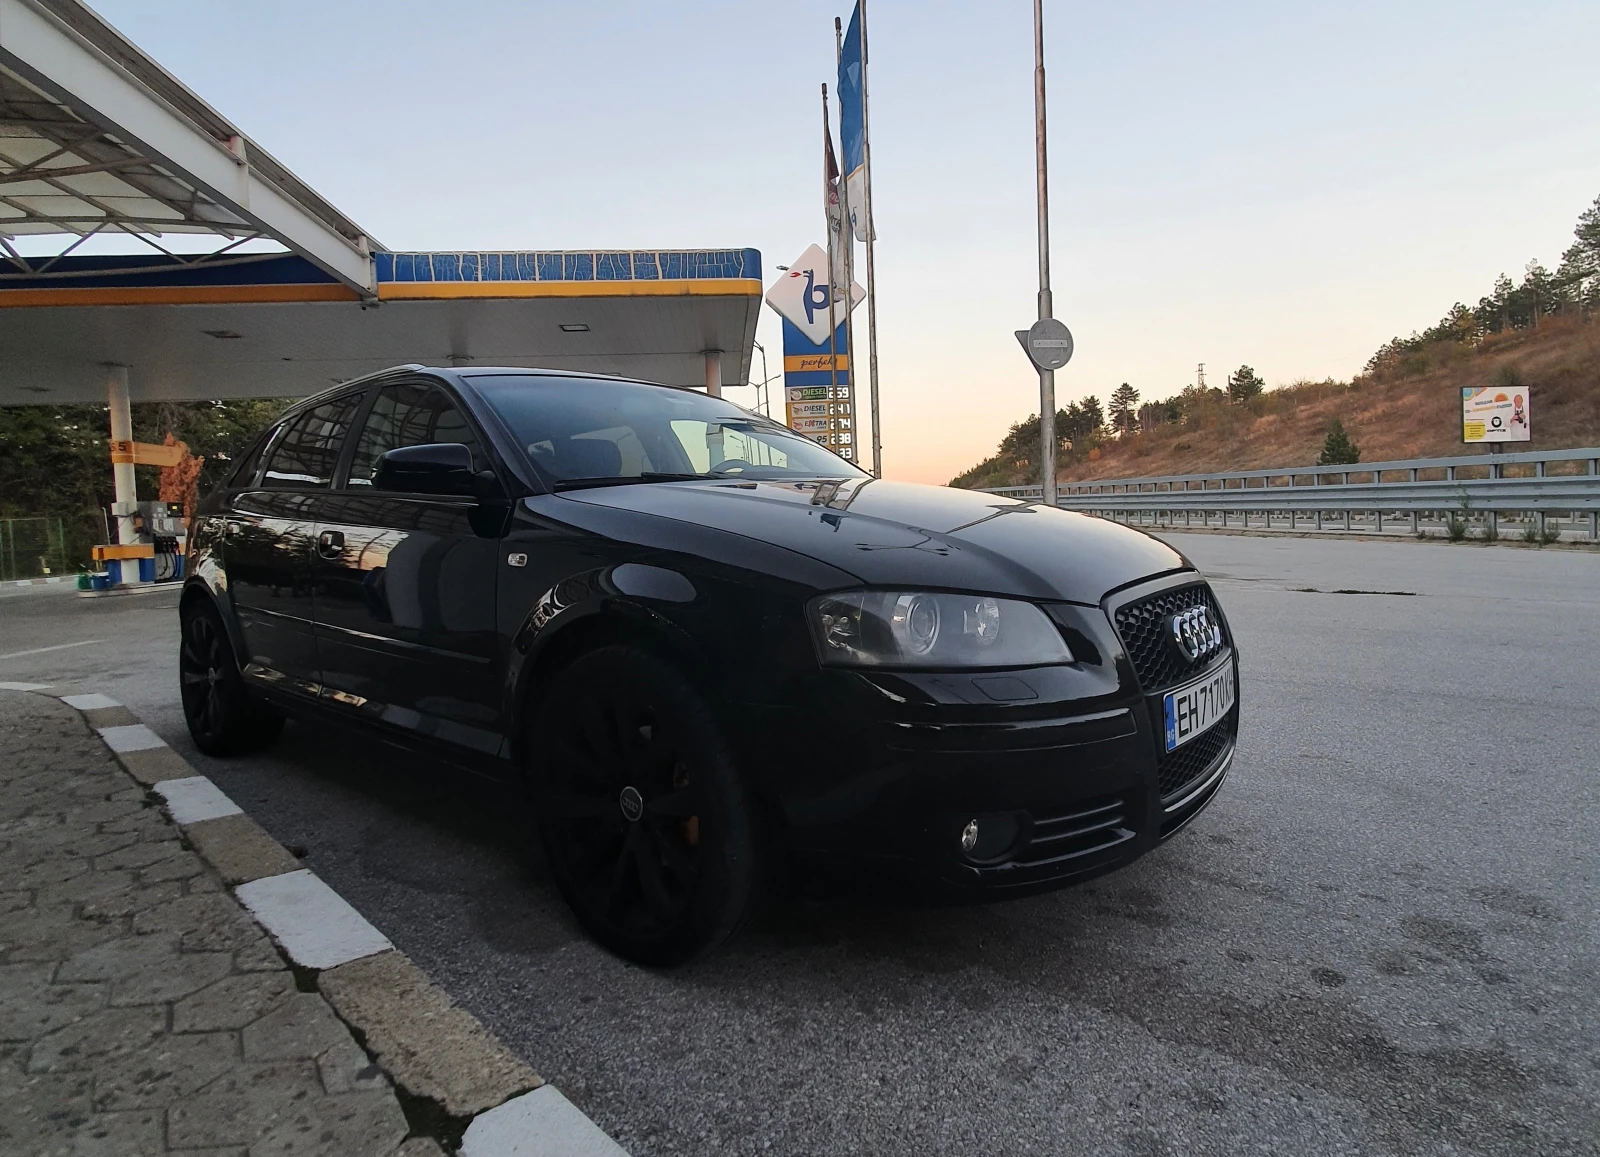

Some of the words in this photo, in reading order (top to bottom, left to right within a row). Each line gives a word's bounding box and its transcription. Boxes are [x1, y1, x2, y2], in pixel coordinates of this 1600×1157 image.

[802, 387, 827, 396] DIESEL
[816, 435, 828, 443] 95
[118, 441, 126, 452] 5
